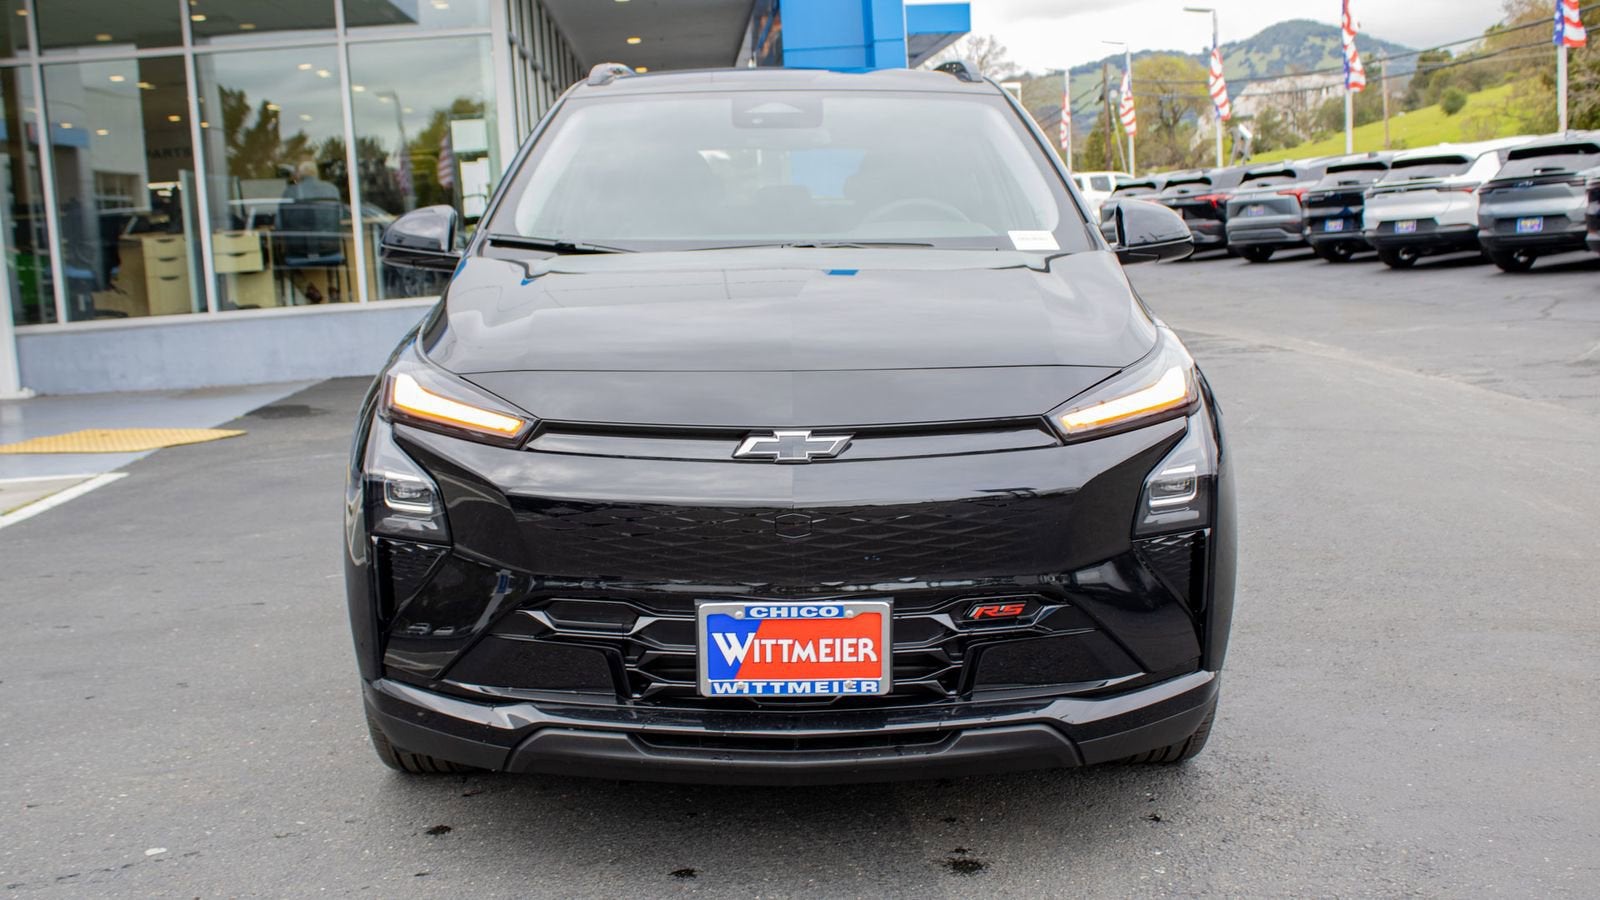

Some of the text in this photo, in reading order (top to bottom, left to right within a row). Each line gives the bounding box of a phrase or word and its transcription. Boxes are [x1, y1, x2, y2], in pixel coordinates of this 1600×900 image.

[750, 606, 839, 618] CHICO
[970, 603, 1026, 620] RS
[712, 632, 878, 667] WITTMEIER
[713, 681, 878, 694] WITTMEIER
